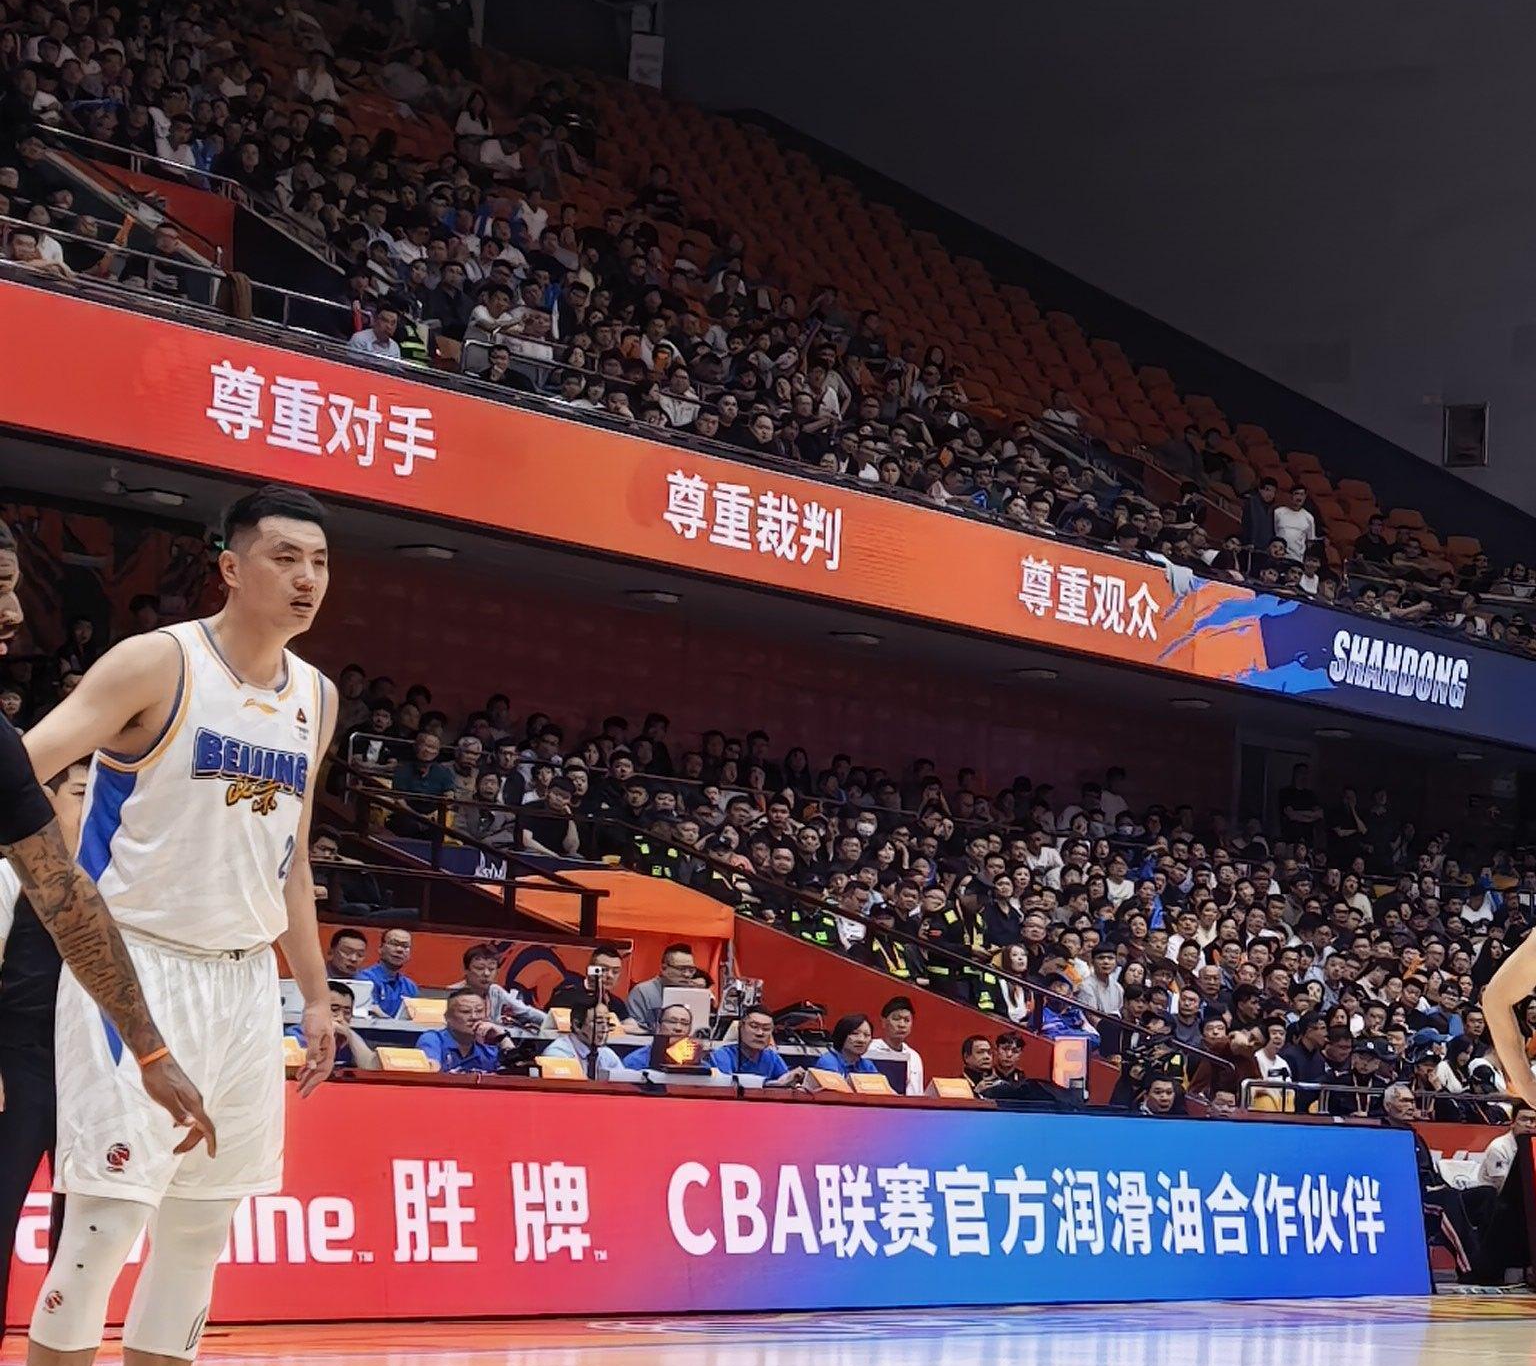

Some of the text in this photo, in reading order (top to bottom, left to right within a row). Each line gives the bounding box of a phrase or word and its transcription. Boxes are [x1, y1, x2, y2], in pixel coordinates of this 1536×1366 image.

[205, 359, 438, 477] 尊重对手
[662, 469, 843, 571] 尊重裁判
[1017, 554, 1160, 641] 尊重观众
[1328, 629, 1471, 710] SHANDONG
[191, 726, 309, 800] BEIJING
[666, 1161, 1386, 1260] CBA联赛官方润滑油合作伙伴
